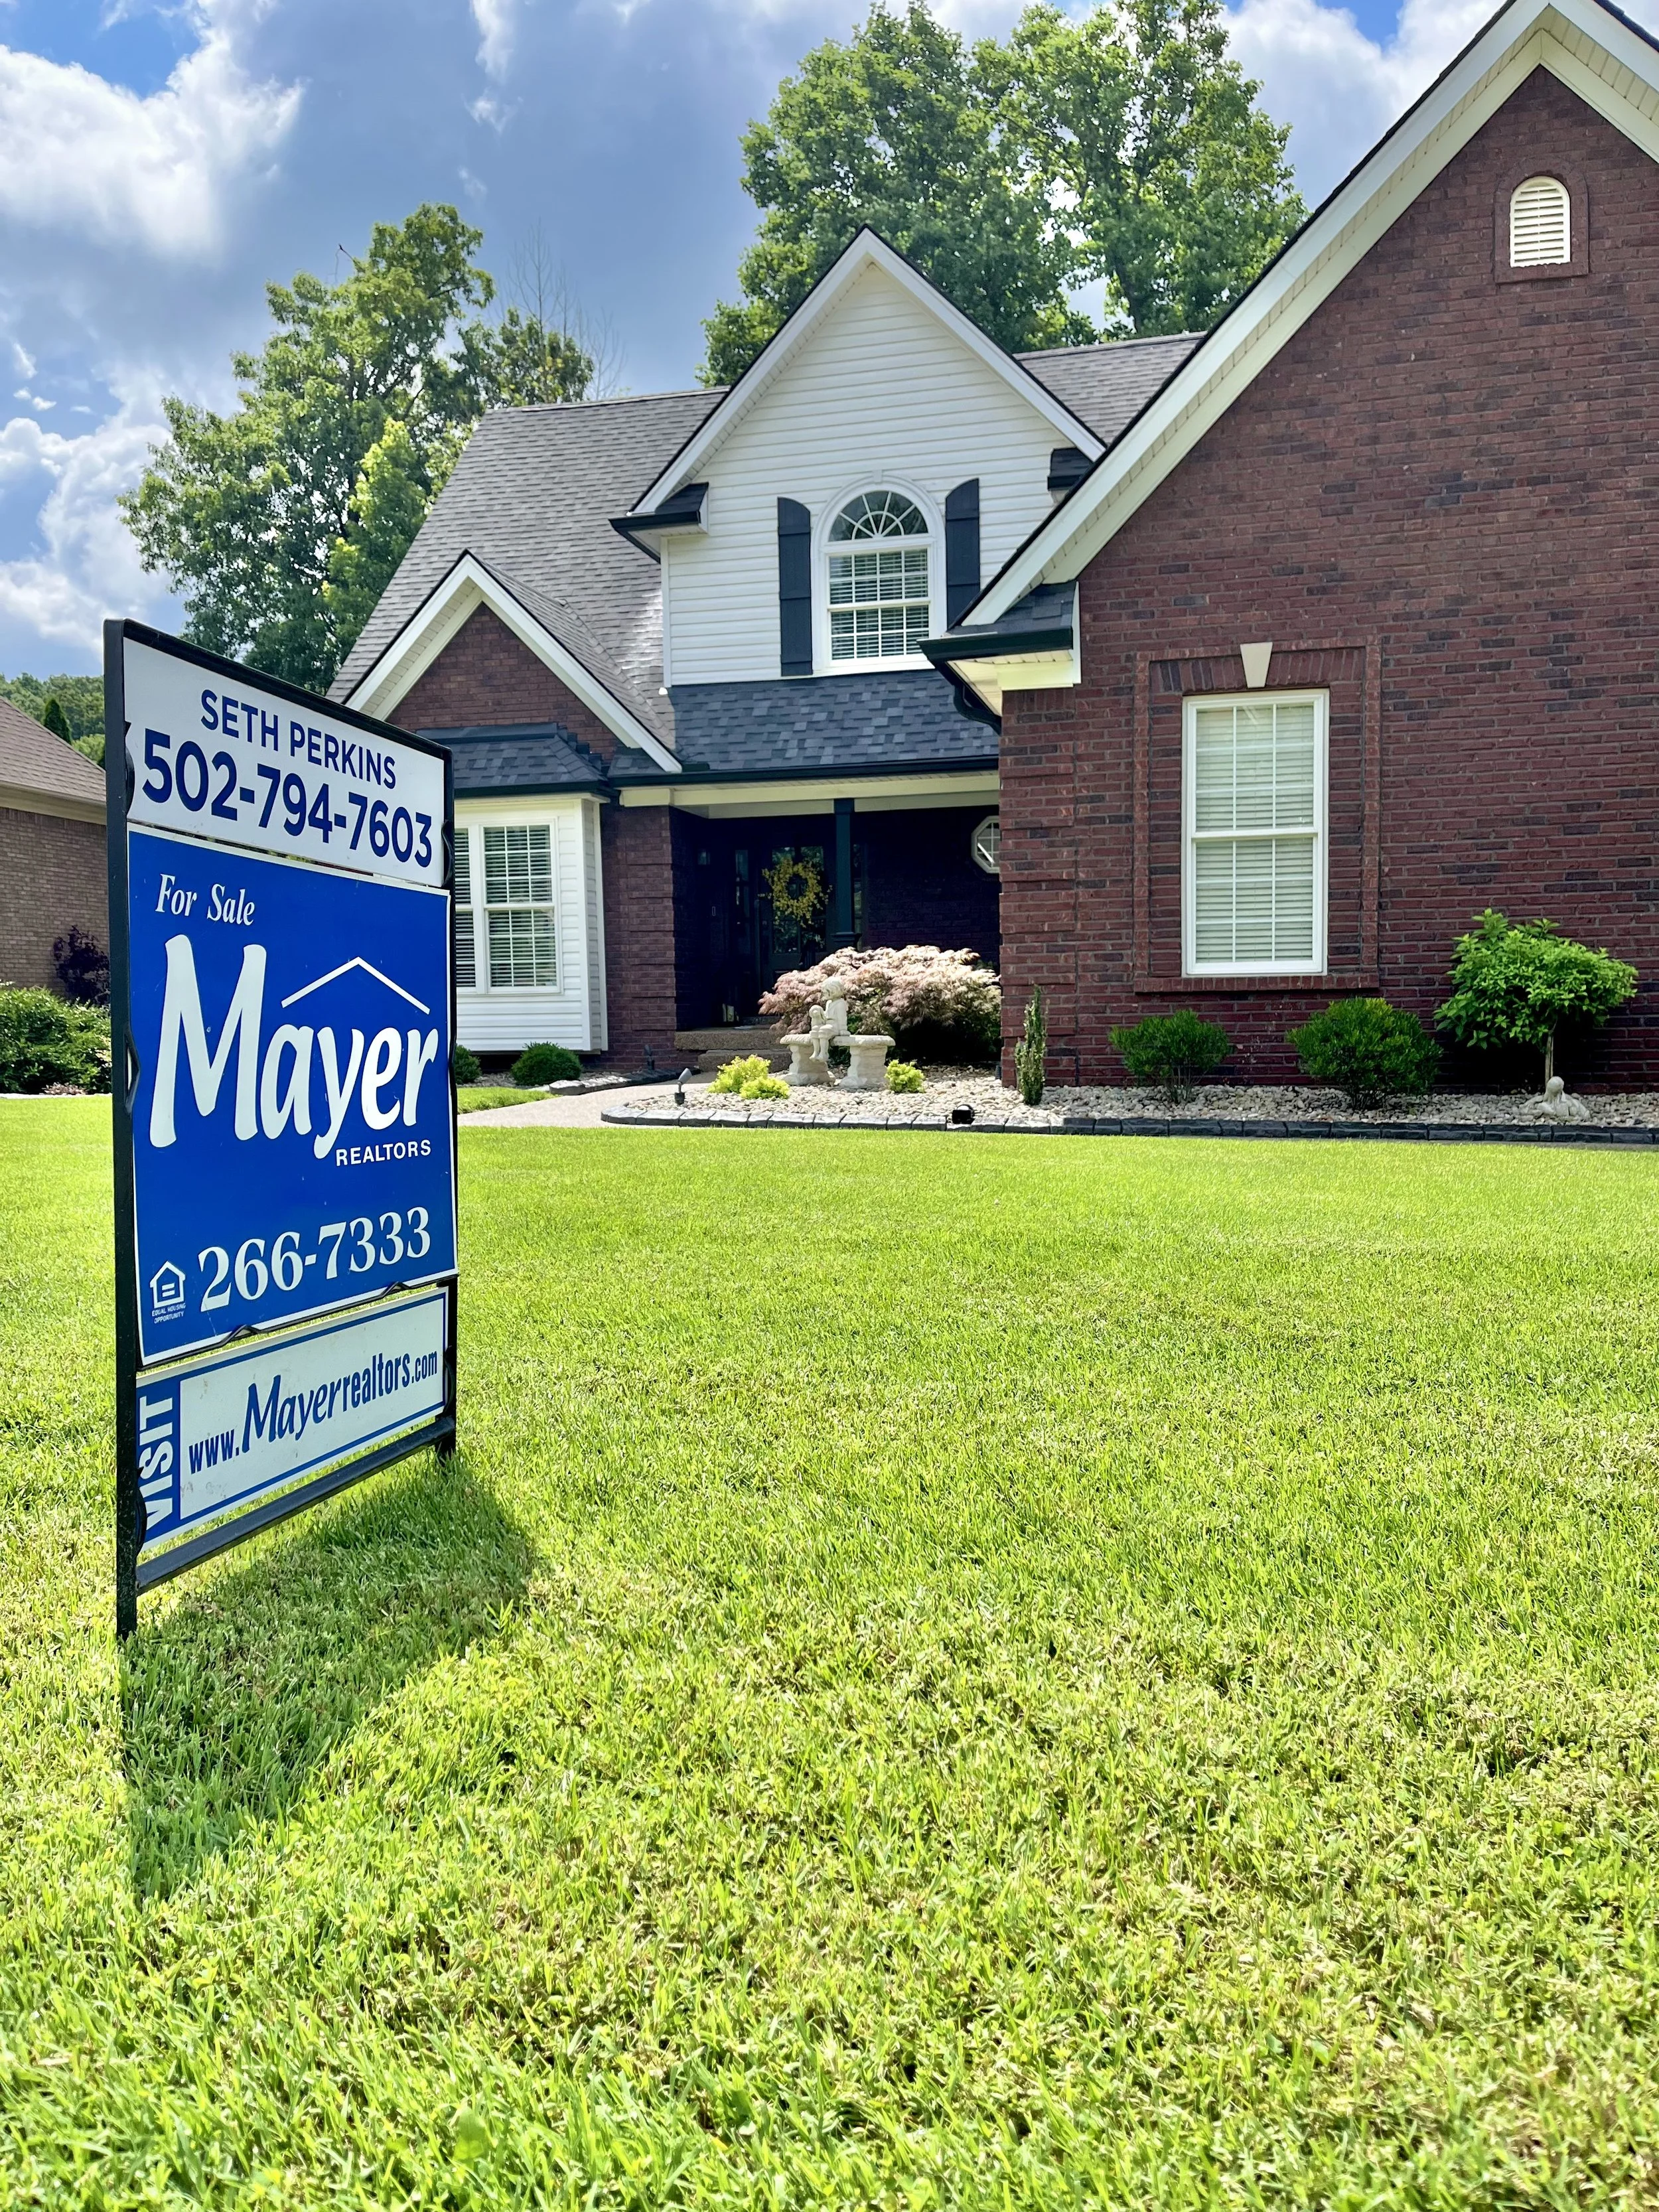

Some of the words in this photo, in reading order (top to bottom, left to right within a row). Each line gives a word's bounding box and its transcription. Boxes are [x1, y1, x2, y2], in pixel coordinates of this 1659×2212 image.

[200, 689, 279, 752] SETH
[290, 720, 396, 790] PERKINS
[142, 727, 433, 868] 502-794-7603
[155, 873, 197, 917] For
[207, 883, 255, 926] Sale
[149, 934, 439, 1159] Mayer
[336, 1139, 431, 1166] REALTORS
[151, 1307, 167, 1317] EQUAL
[167, 1303, 186, 1312] HOUSING
[198, 1207, 431, 1312] 266-7333
[154, 1311, 184, 1324] OPPORTUNITY
[139, 1396, 173, 1530] VISIT
[188, 1350, 438, 1475] www.Mayerrealtors.com
